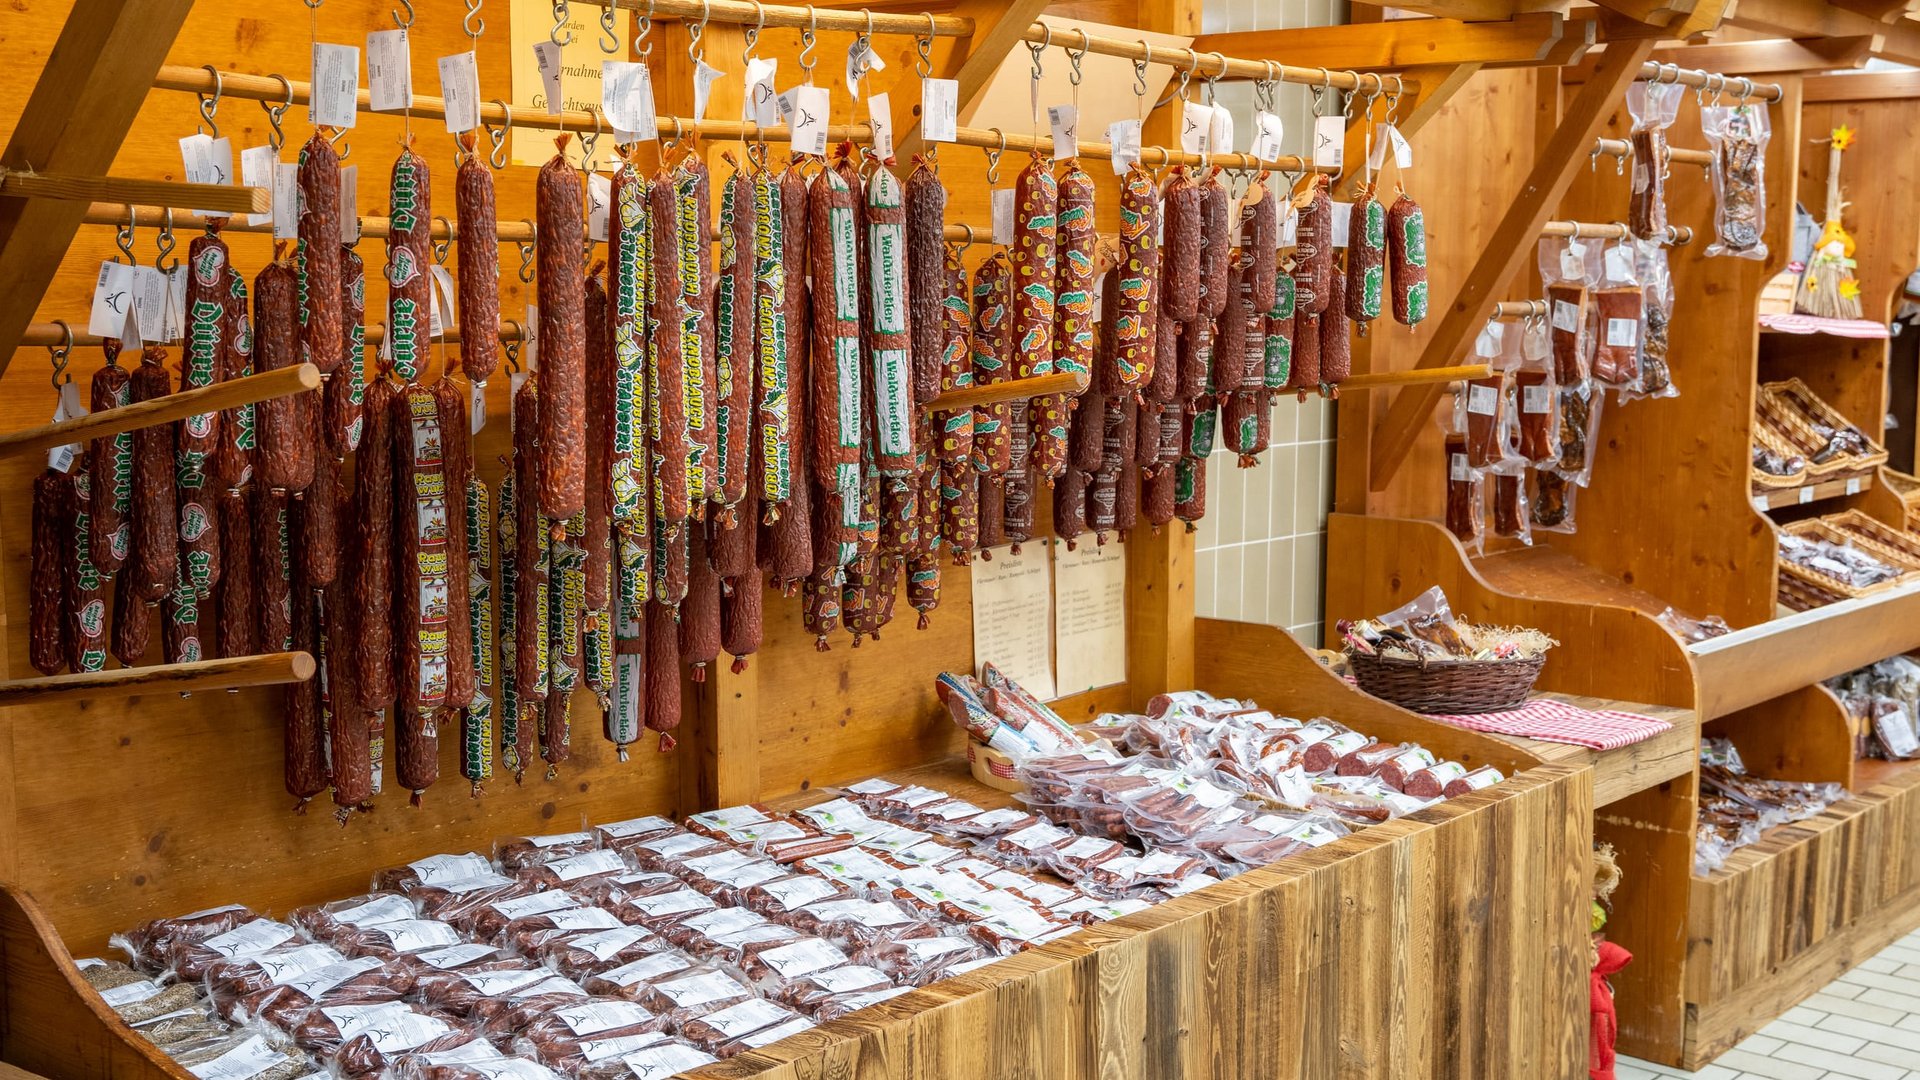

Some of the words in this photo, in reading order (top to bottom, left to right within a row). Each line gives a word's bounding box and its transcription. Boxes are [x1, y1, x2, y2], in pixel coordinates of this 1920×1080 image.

[561, 20, 585, 30] urden
[619, 231, 636, 316] STANGERL
[633, 234, 647, 334] KNOBLAUCH
[682, 199, 699, 296] KNOBLAUCH
[882, 235, 896, 325] Waldviertler
[190, 300, 224, 387] Dürre
[390, 298, 415, 380] Dürre
[688, 334, 704, 430] KNOBLAUCH
[761, 296, 777, 389] KNOBLAUCH
[615, 369, 632, 453] STANGERL
[631, 373, 645, 470] KNOBLAUCH
[885, 359, 900, 448] Waldviertler
[478, 482, 490, 568] KNOBLAUCH
[481, 601, 492, 686] KNOBLAUCH
[537, 584, 549, 672] KNOBLAUCH
[564, 569, 578, 656] KNOBLAUCH
[620, 663, 632, 742] Waldviertler
[481, 718, 493, 779] KNOBLAU
